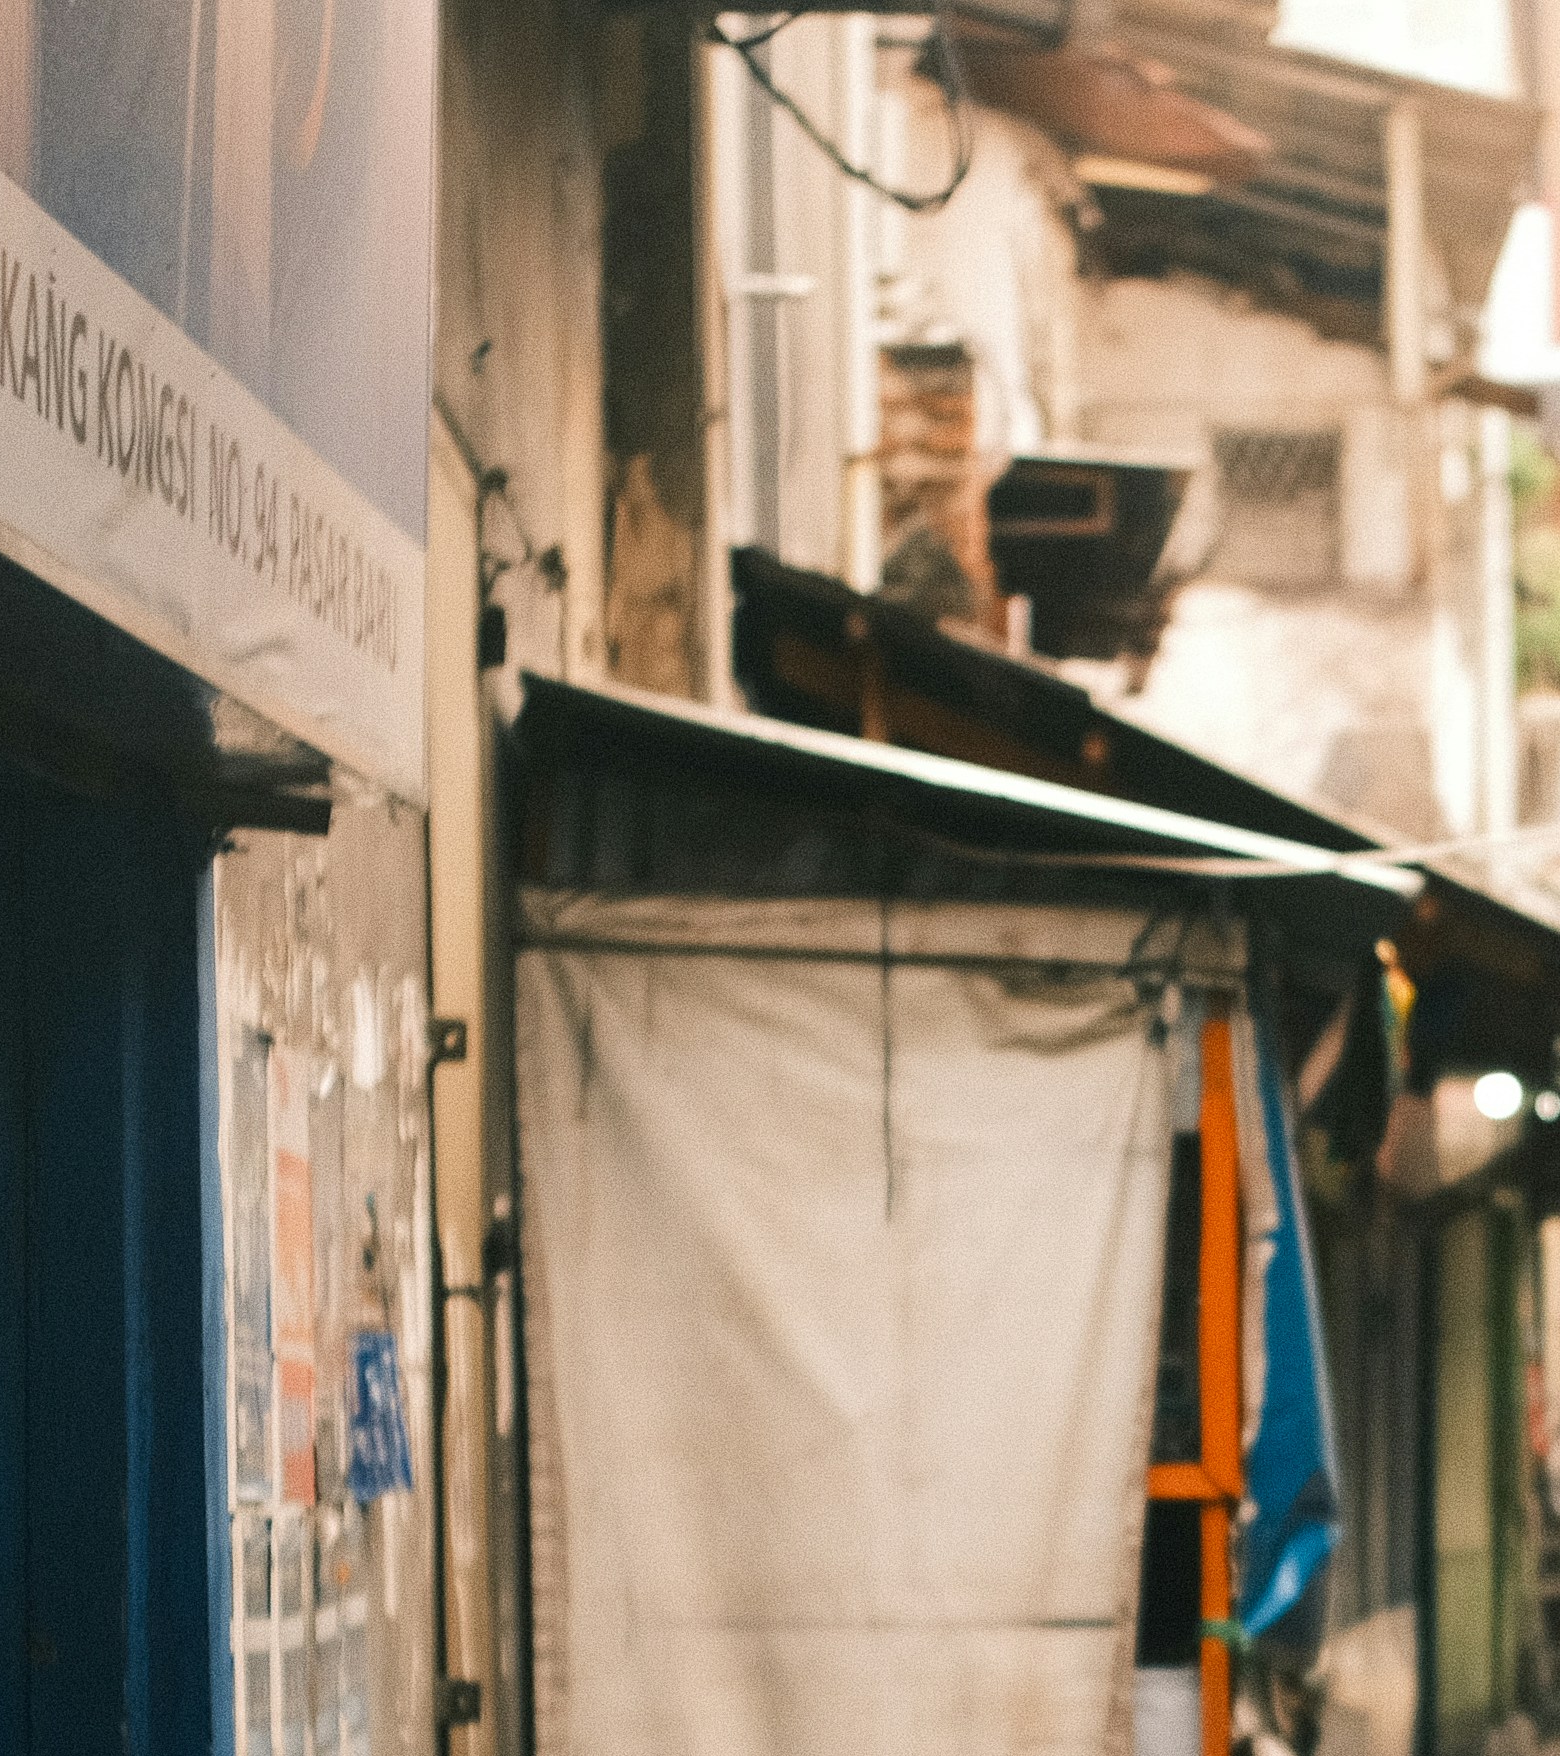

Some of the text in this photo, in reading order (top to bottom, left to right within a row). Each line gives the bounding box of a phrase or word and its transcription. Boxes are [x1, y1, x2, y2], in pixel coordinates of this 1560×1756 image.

[97, 330, 196, 524] KONGSI
[253, 461, 278, 588] 94
[288, 491, 349, 638] PASAR
[352, 546, 399, 675] BARU
